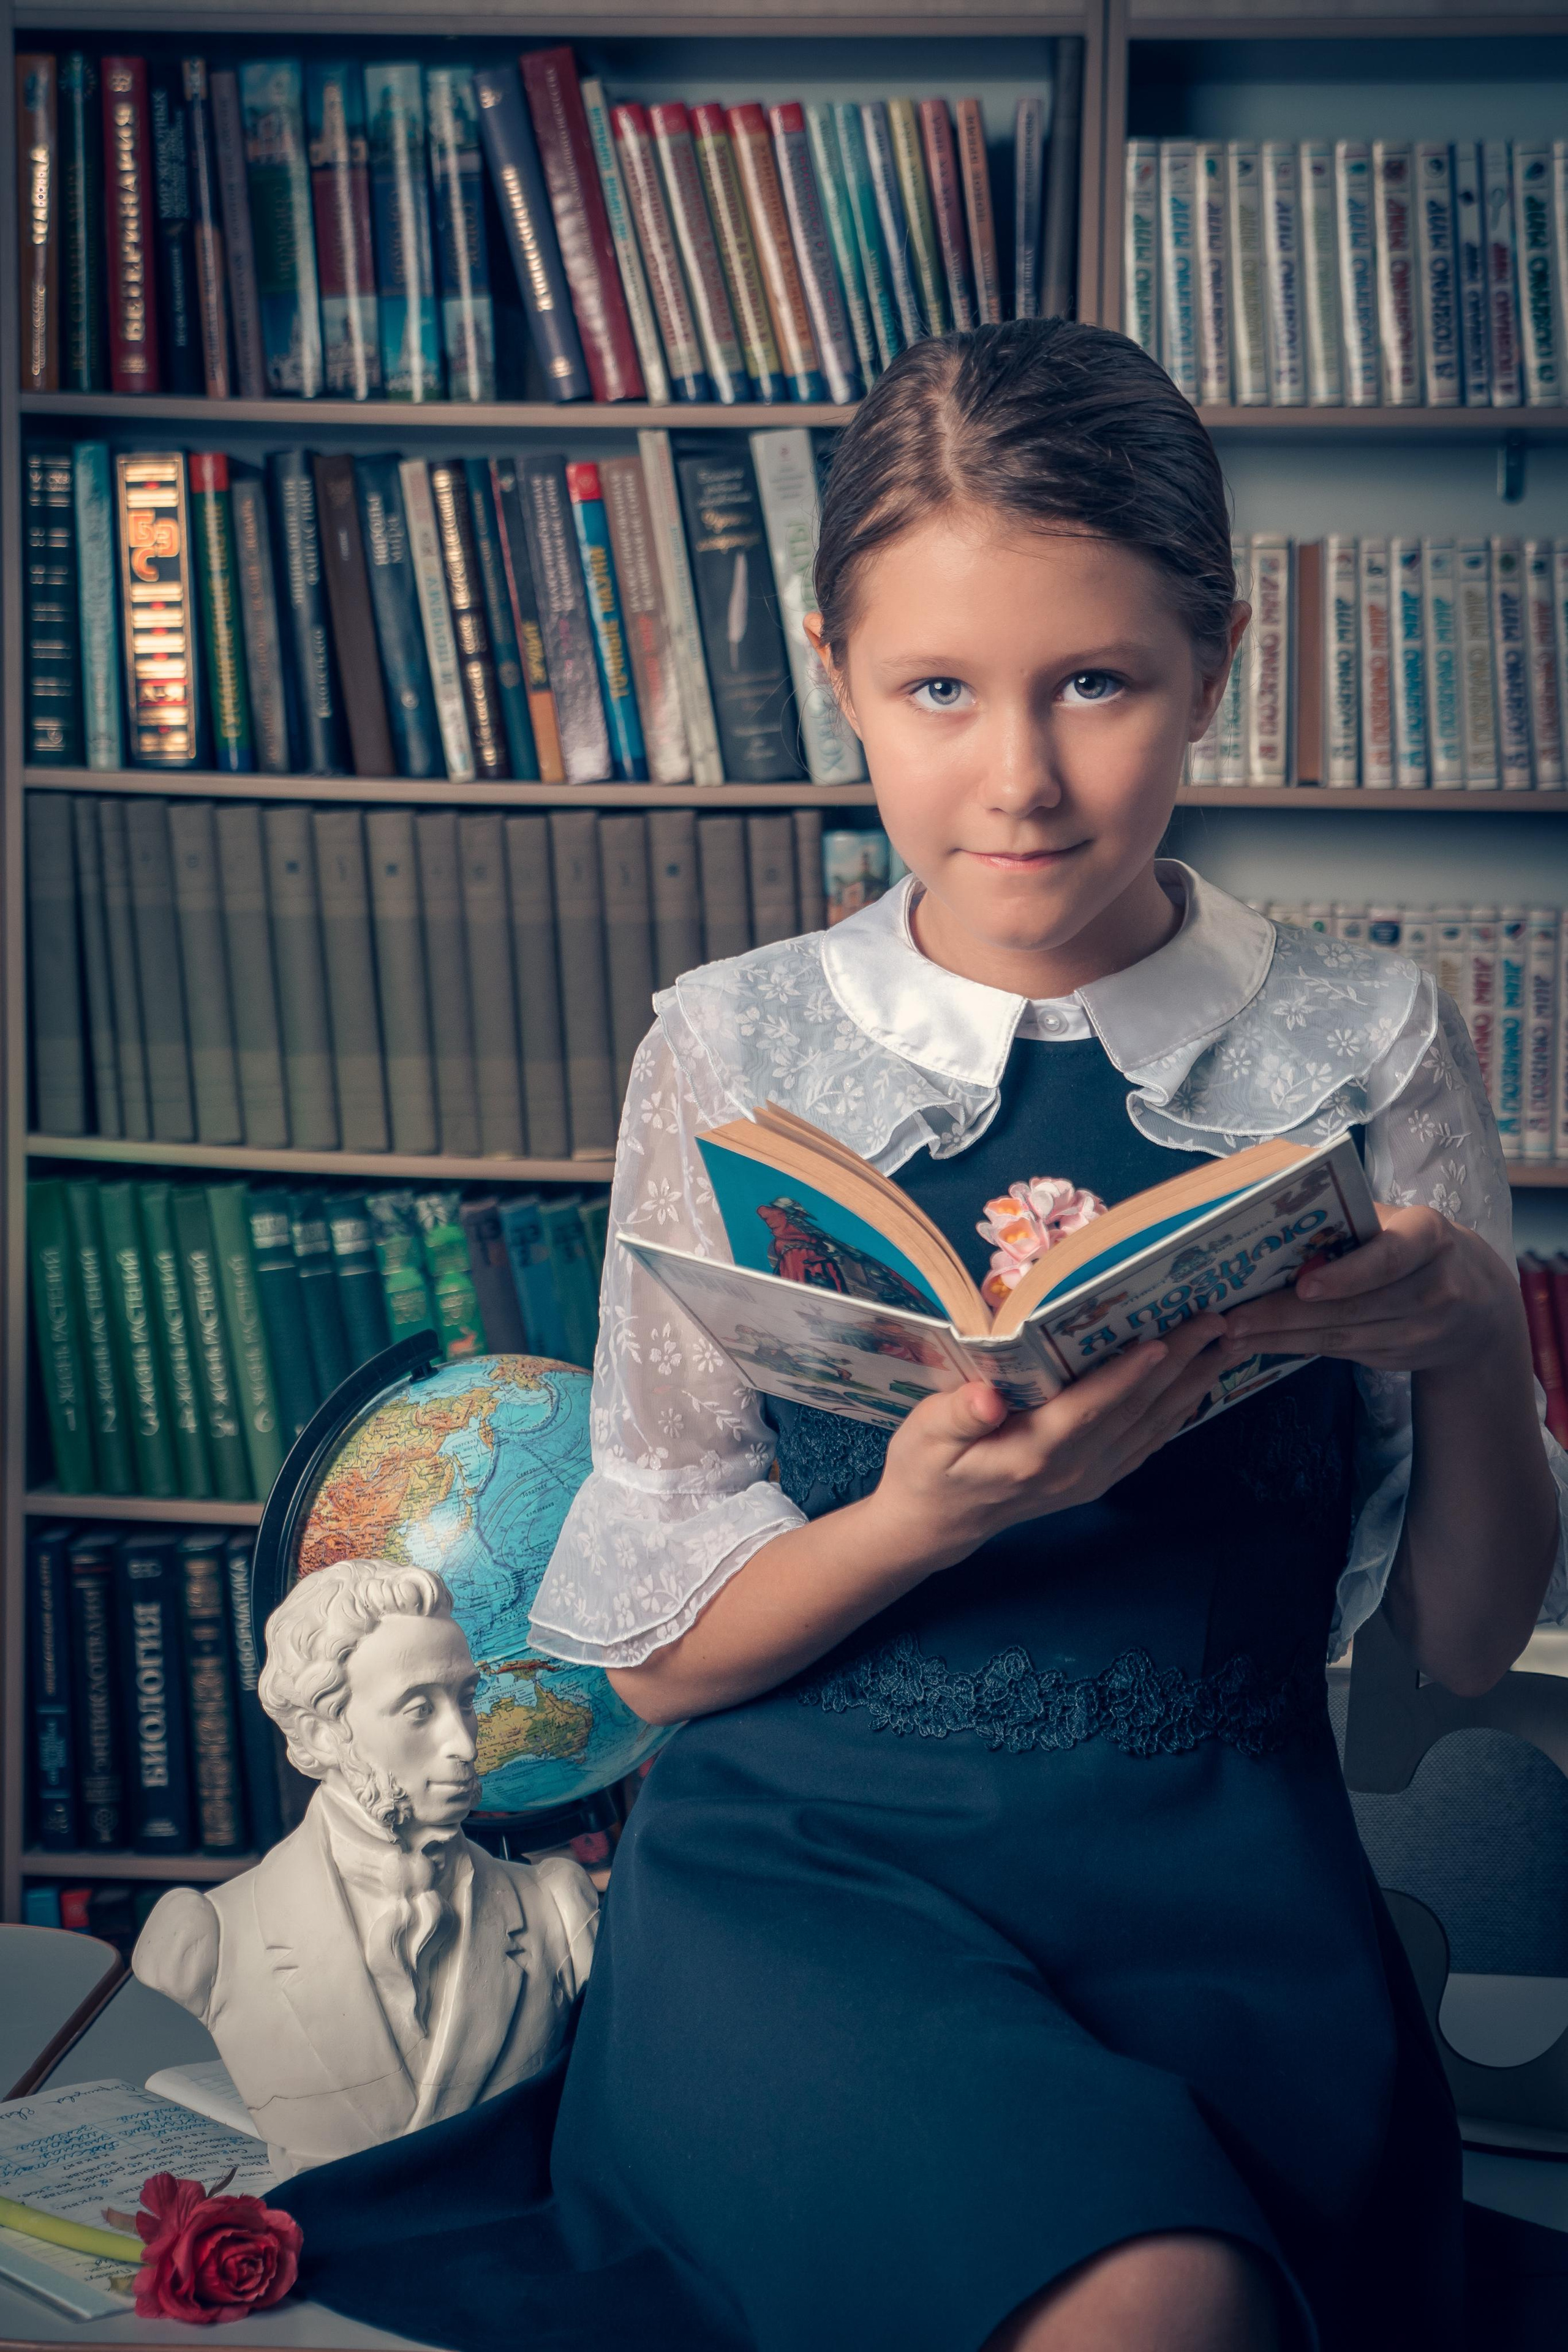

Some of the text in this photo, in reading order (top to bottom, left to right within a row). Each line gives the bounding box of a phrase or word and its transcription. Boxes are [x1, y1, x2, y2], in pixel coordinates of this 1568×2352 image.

[113, 100, 146, 342] ВЕТЕРИНАРИЯ
[1170, 197, 1189, 249] МИР
[1348, 198, 1368, 249] МИР
[1426, 200, 1448, 252] МИР
[1524, 195, 1546, 251] МИР
[1173, 257, 1193, 357] ПОЗНАЮ
[1429, 257, 1453, 356] ПОЗНАЮ
[1527, 257, 1553, 358] ПОЗНАЮ
[284, 478, 304, 606] ЭНЦИКЛОПЕДИЯ
[301, 478, 320, 586] ФАНТАСТИКИ
[530, 474, 562, 613] ИЛЛЮСТРИРОВАННАЯ
[609, 472, 641, 613] ИЛЛЮСТРИРОВАННАЯ
[590, 544, 630, 699] ТОЧНЫЕ НАУКИ
[1259, 577, 1279, 626] МИР
[1334, 598, 1352, 644] МИР
[1401, 590, 1419, 641] МИР
[1432, 597, 1453, 645] МИР
[1464, 590, 1490, 641] МИР
[1500, 590, 1520, 641] МИР
[208, 577, 242, 739] ГУМАНИТАРНЫЕ
[1258, 634, 1279, 736] ПОЗНАЮ
[1434, 650, 1457, 739] ПОЗНАЮ
[1468, 647, 1493, 745] ПОЗНАЮ
[1502, 959, 1523, 1009] МИР
[1499, 1017, 1521, 1114] ПОЗНАЮ
[40, 1246, 74, 1403] ЖИЗНЬ РАСТЕНИЙ
[78, 1246, 115, 1404] ЖИЗНЬ РАСТЕНИЙ
[115, 1248, 157, 1406] ЖИЗНЬ РАСТЕНИЙ
[154, 1250, 193, 1405] ЖИЗНЬ РАСТЕНИЙ
[188, 1250, 230, 1406] ЖИЗНЬ РАСТЕНИЙ
[227, 1253, 266, 1405] ЖИЗНЬ РАСТЕНИЙ
[1079, 1207, 1329, 1358] Я ПОЗНАЮ
[1154, 1262, 1257, 1333] МИР
[63, 1407, 77, 1431] 1
[100, 1406, 116, 1433] 2
[139, 1407, 159, 1436] 3
[177, 1408, 198, 1434] 4
[209, 1411, 238, 1438] 5
[253, 1407, 275, 1433] 6
[521, 1483, 548, 1498] Западная
[228, 1559, 257, 1692] ИНФОРМАТИКА
[83, 1589, 111, 1772] ЭНЦИКЛОПЕДИЯ
[132, 1601, 170, 1788] БИОЛОГИЯ
[62, 2132, 206, 2170] какой? какая?
[55, 2196, 104, 2211] буквы.
